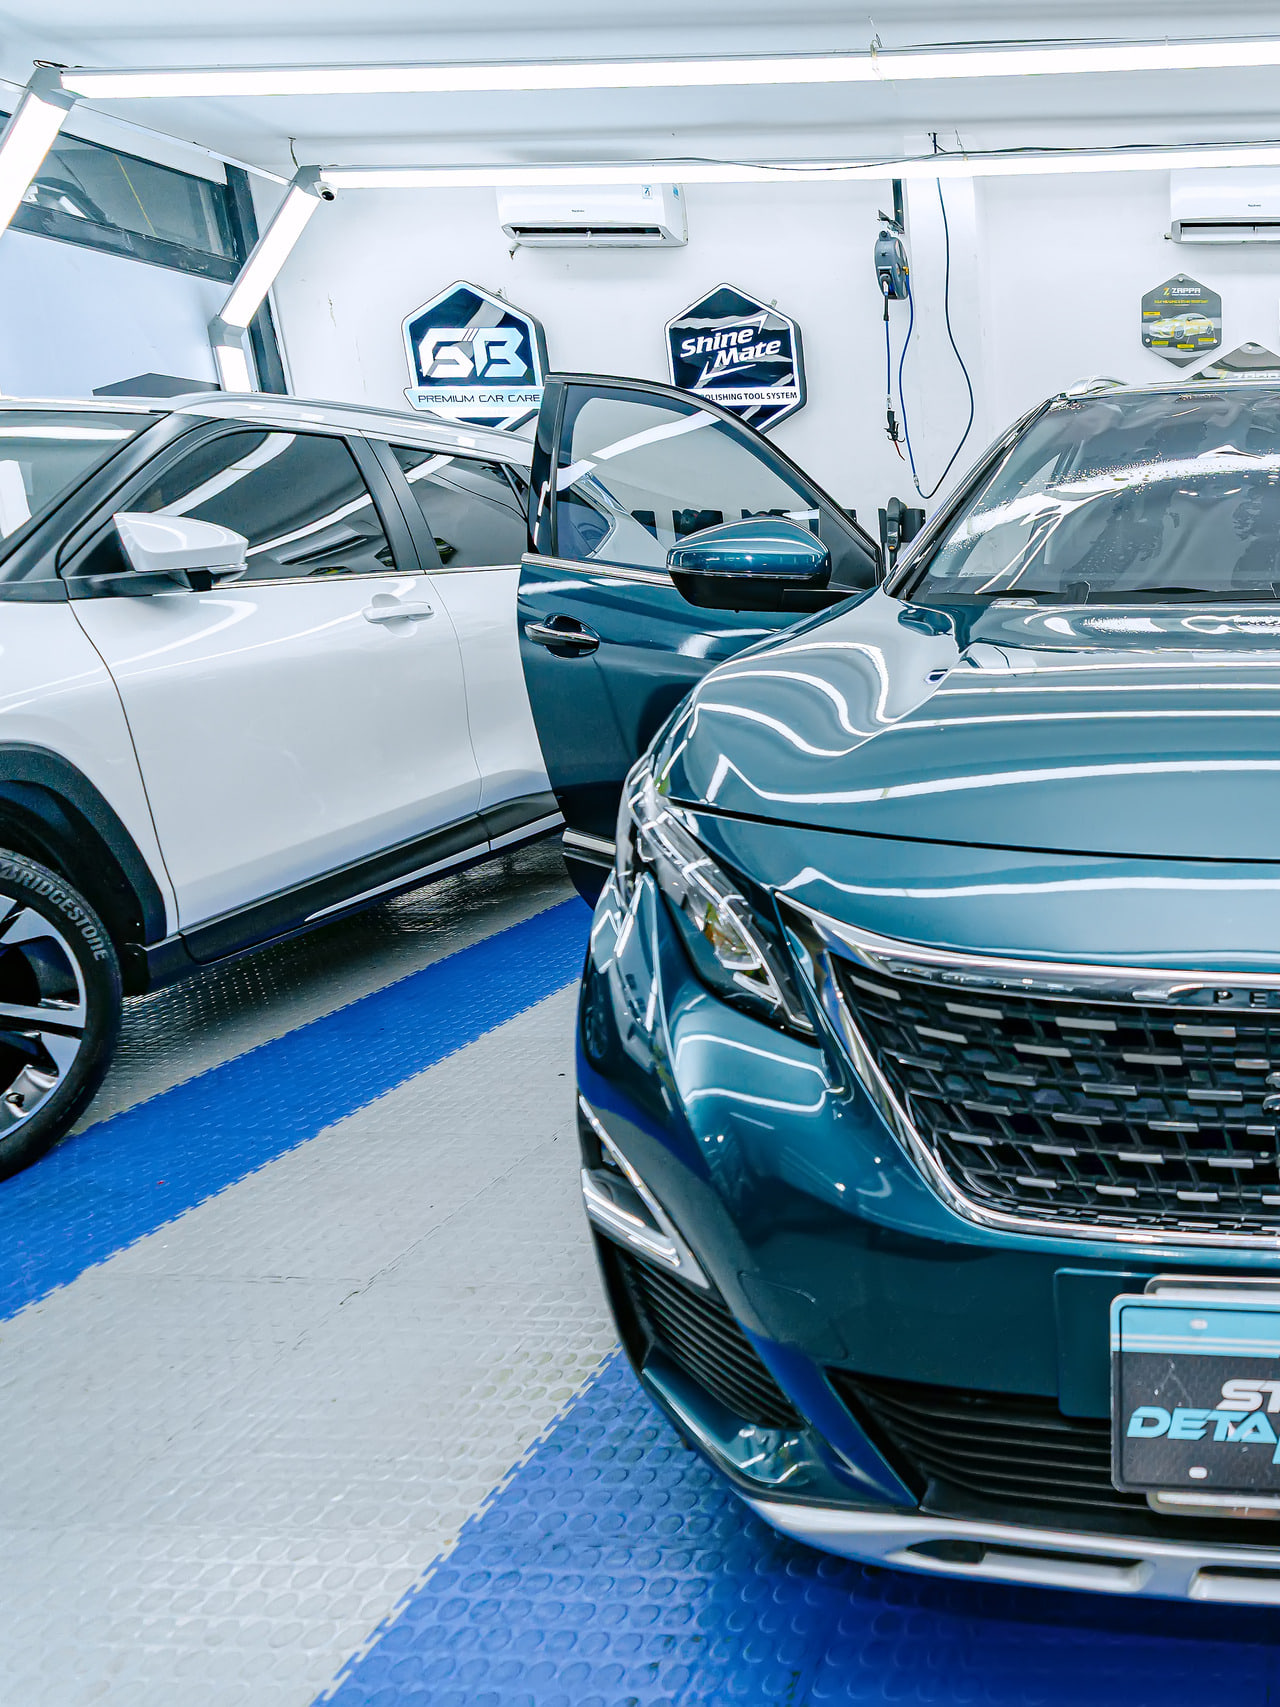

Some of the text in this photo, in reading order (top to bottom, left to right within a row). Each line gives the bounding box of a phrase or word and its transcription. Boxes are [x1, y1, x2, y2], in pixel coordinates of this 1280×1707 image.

[680, 328, 754, 358] Shine
[713, 340, 782, 368] Mate
[418, 394, 541, 403] PREMIUM CAR CARE
[743, 392, 765, 400] TOOL
[766, 391, 798, 400] SYSTEM
